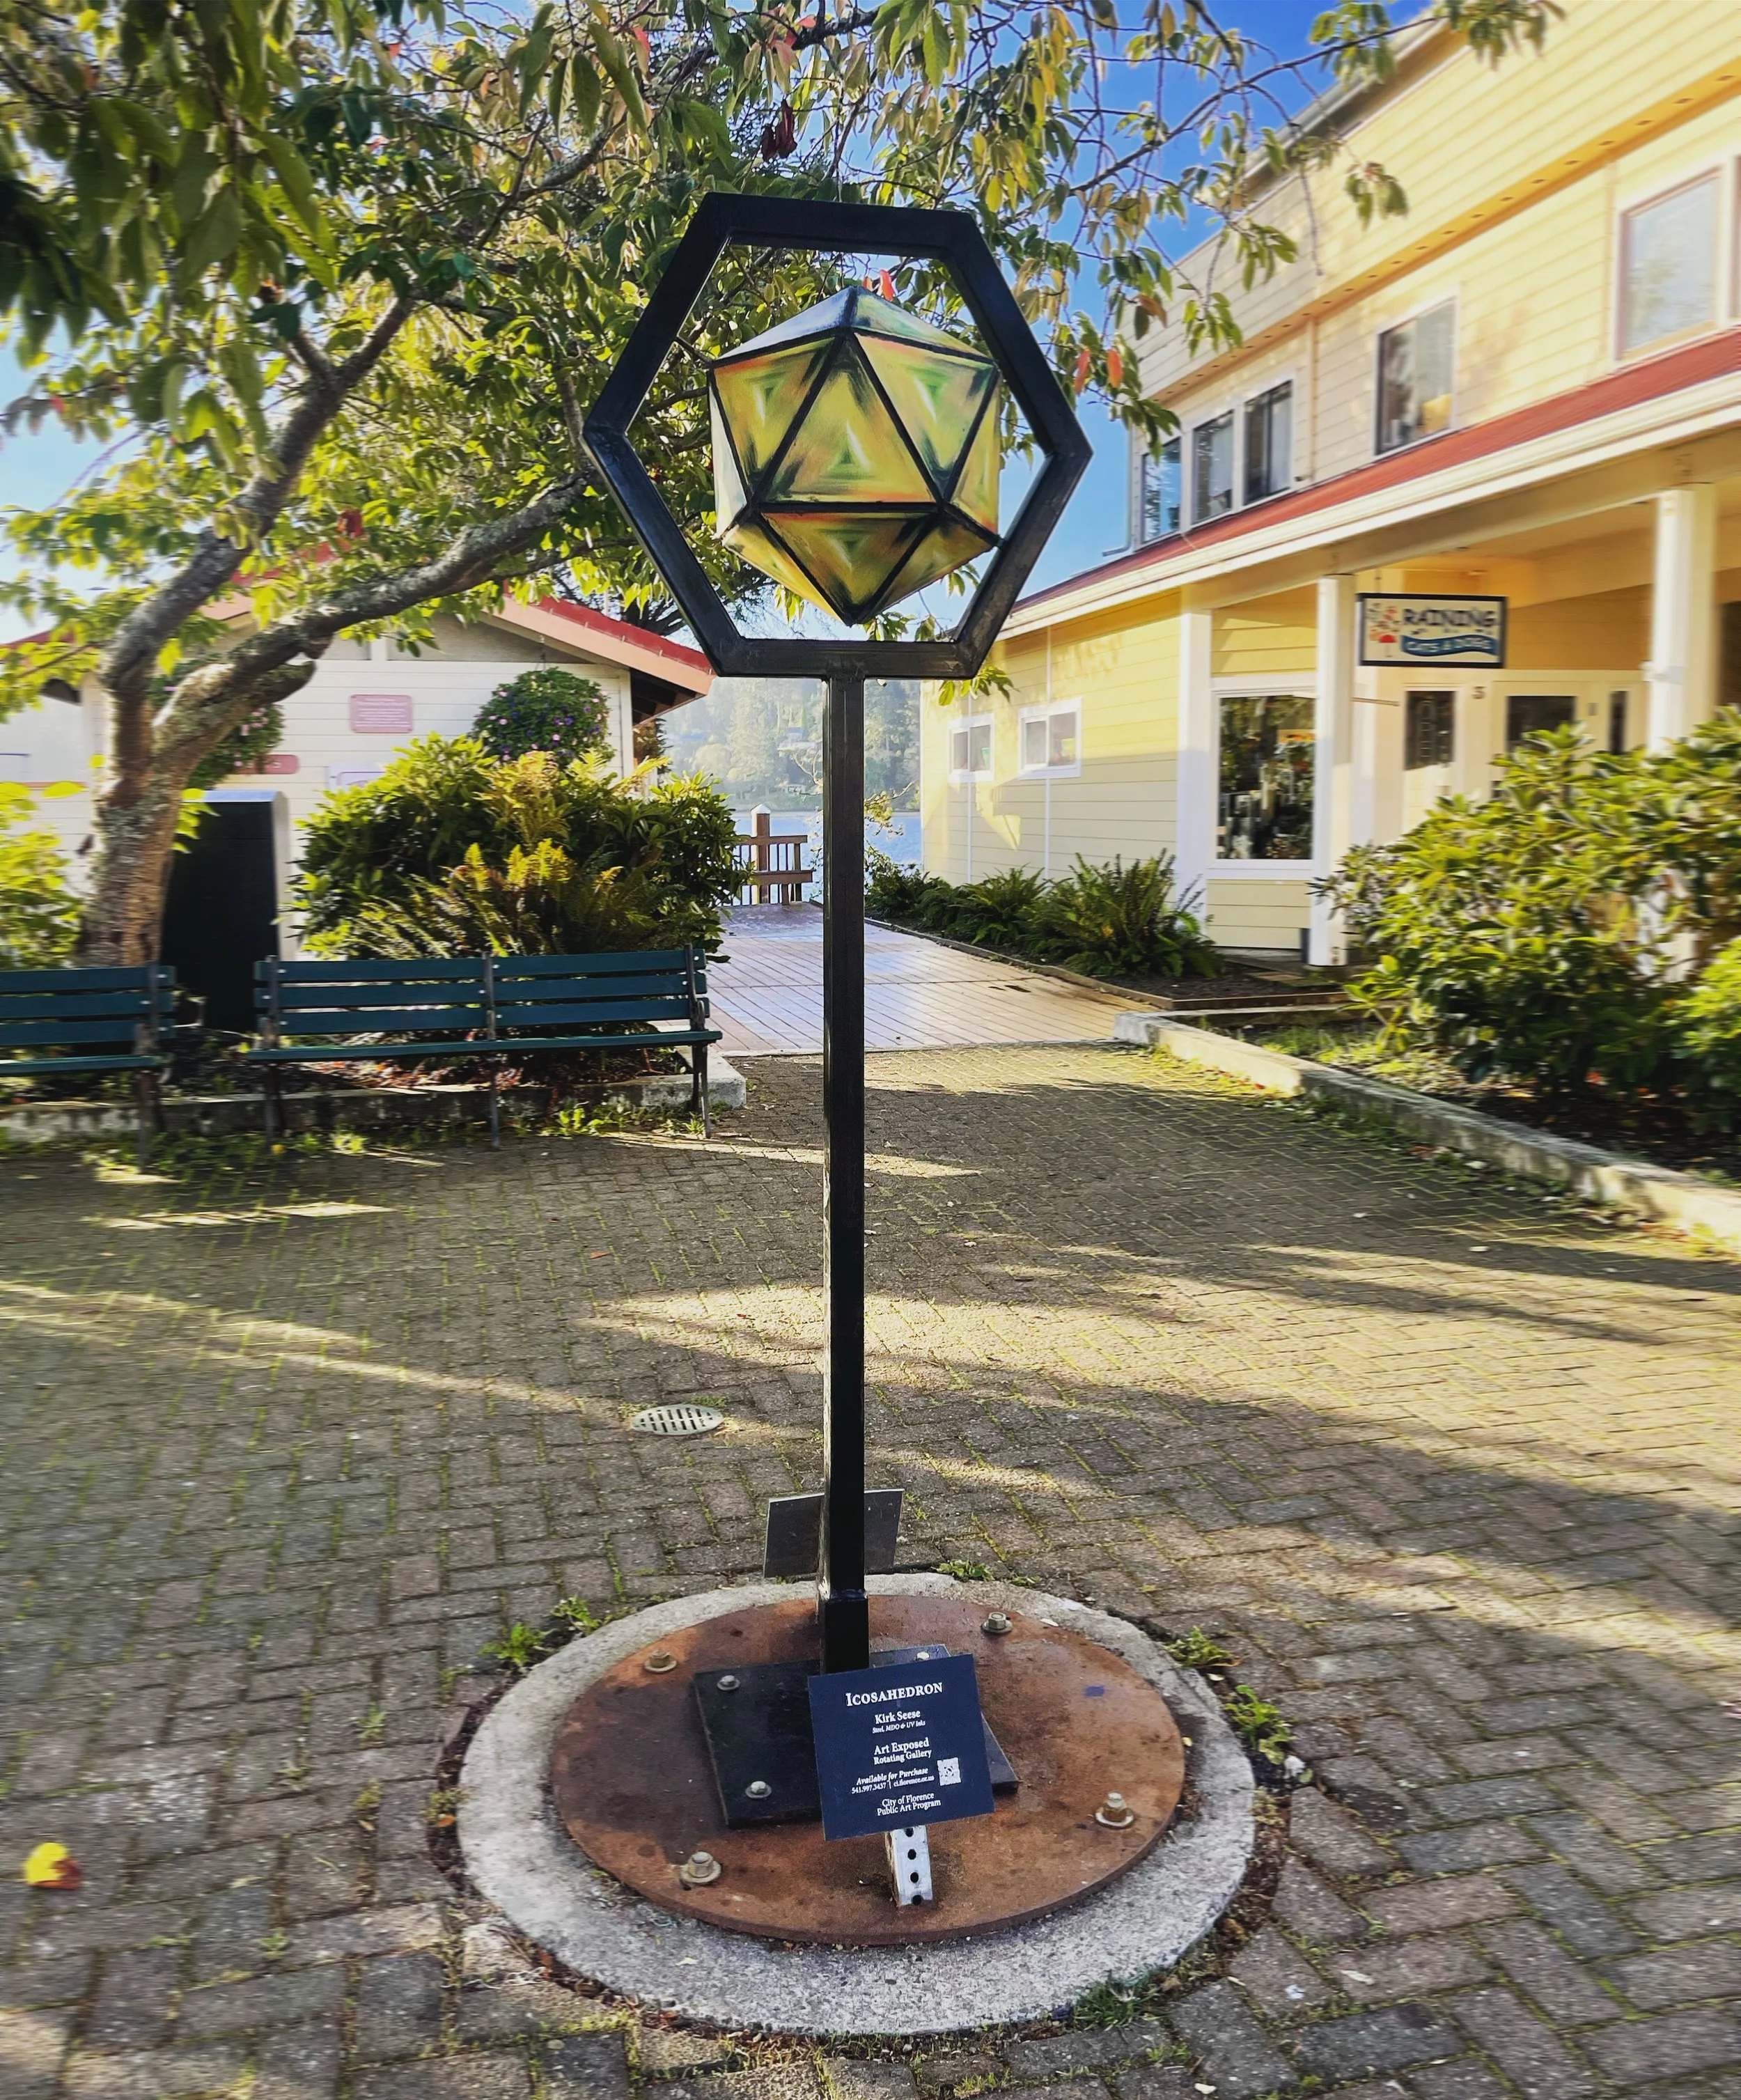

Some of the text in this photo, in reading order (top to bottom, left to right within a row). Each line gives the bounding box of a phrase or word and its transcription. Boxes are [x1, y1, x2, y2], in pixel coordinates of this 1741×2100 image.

[875, 1711, 921, 1724] Kirk Seese
[874, 1736, 929, 1755] Art Exposed
[873, 1750, 932, 1765] Rotating Gallery
[856, 1768, 928, 1785] Available for Purchase
[877, 1806, 898, 1817] Public
[912, 1800, 941, 1810] Program
[882, 1793, 935, 1810] City of Florence
